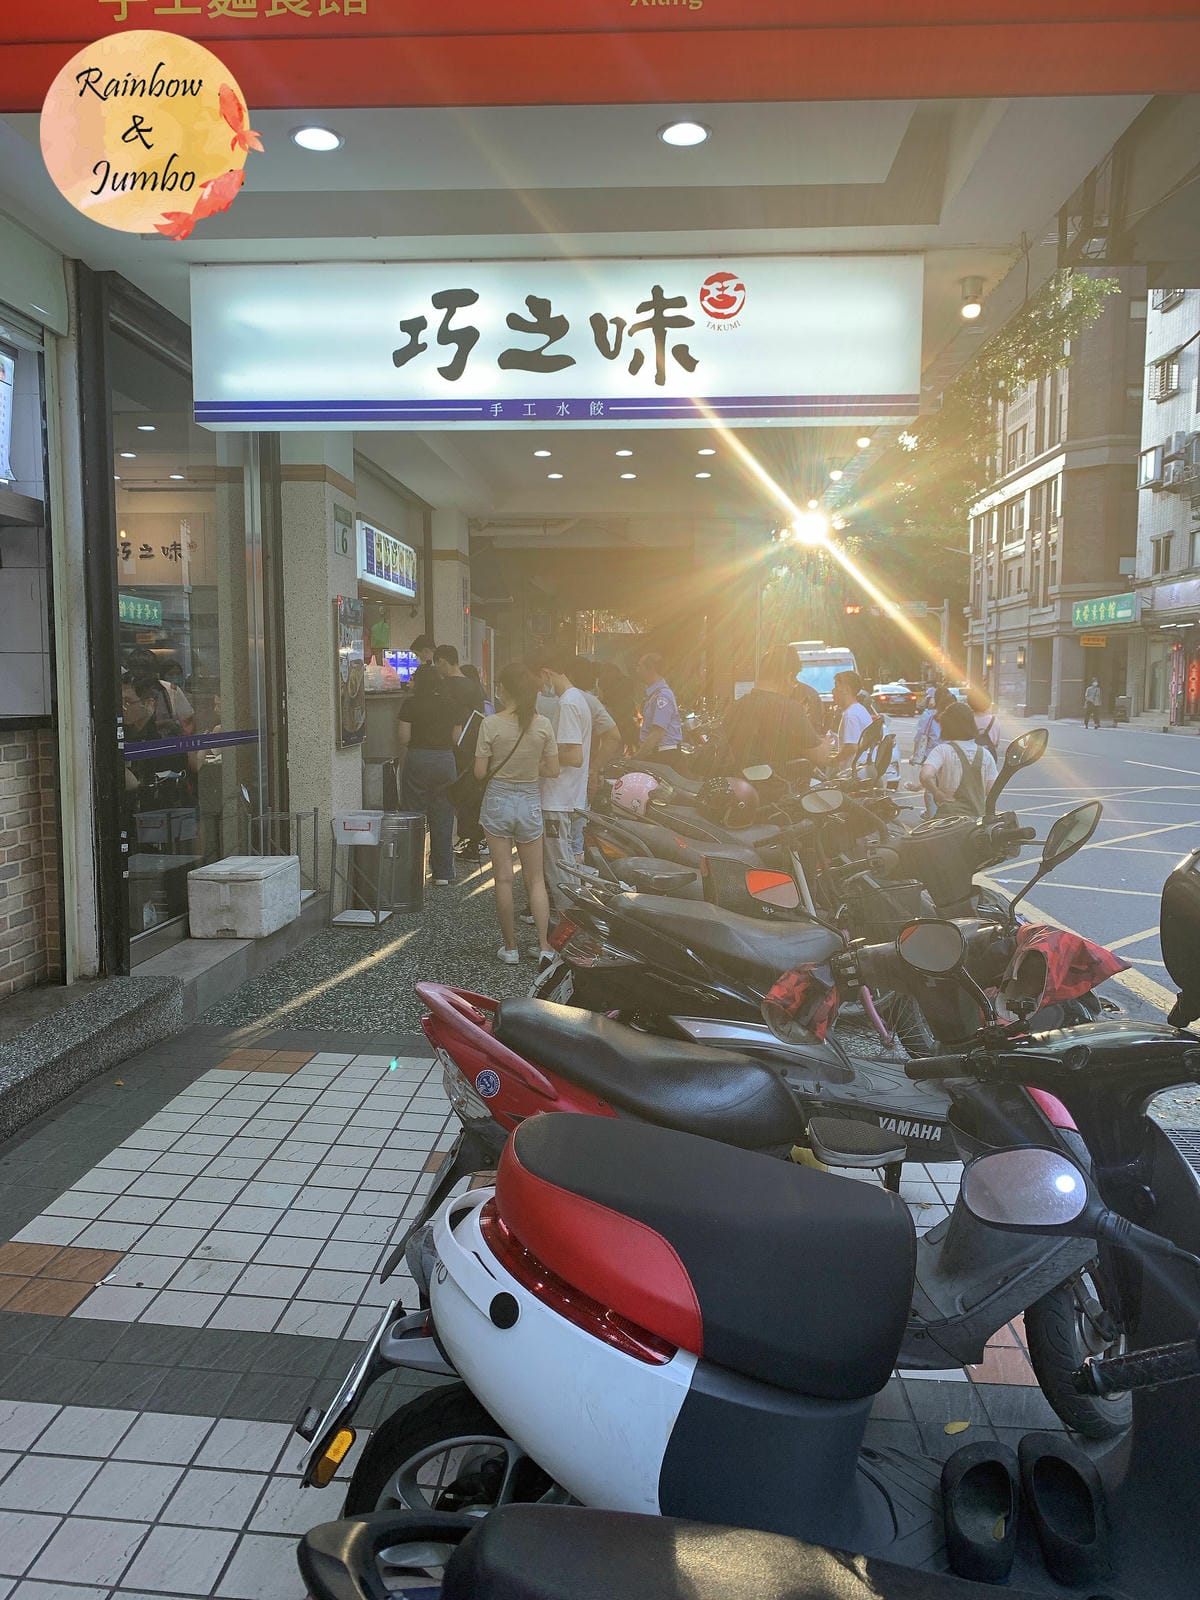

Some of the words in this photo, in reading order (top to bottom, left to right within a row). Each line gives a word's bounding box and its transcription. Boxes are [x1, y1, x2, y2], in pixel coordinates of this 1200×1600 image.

[392, 284, 700, 386] 巧之味
[706, 320, 741, 331] TAKUMI
[489, 401, 605, 417] 手工水餃
[879, 1117, 943, 1141] YAMAHA
